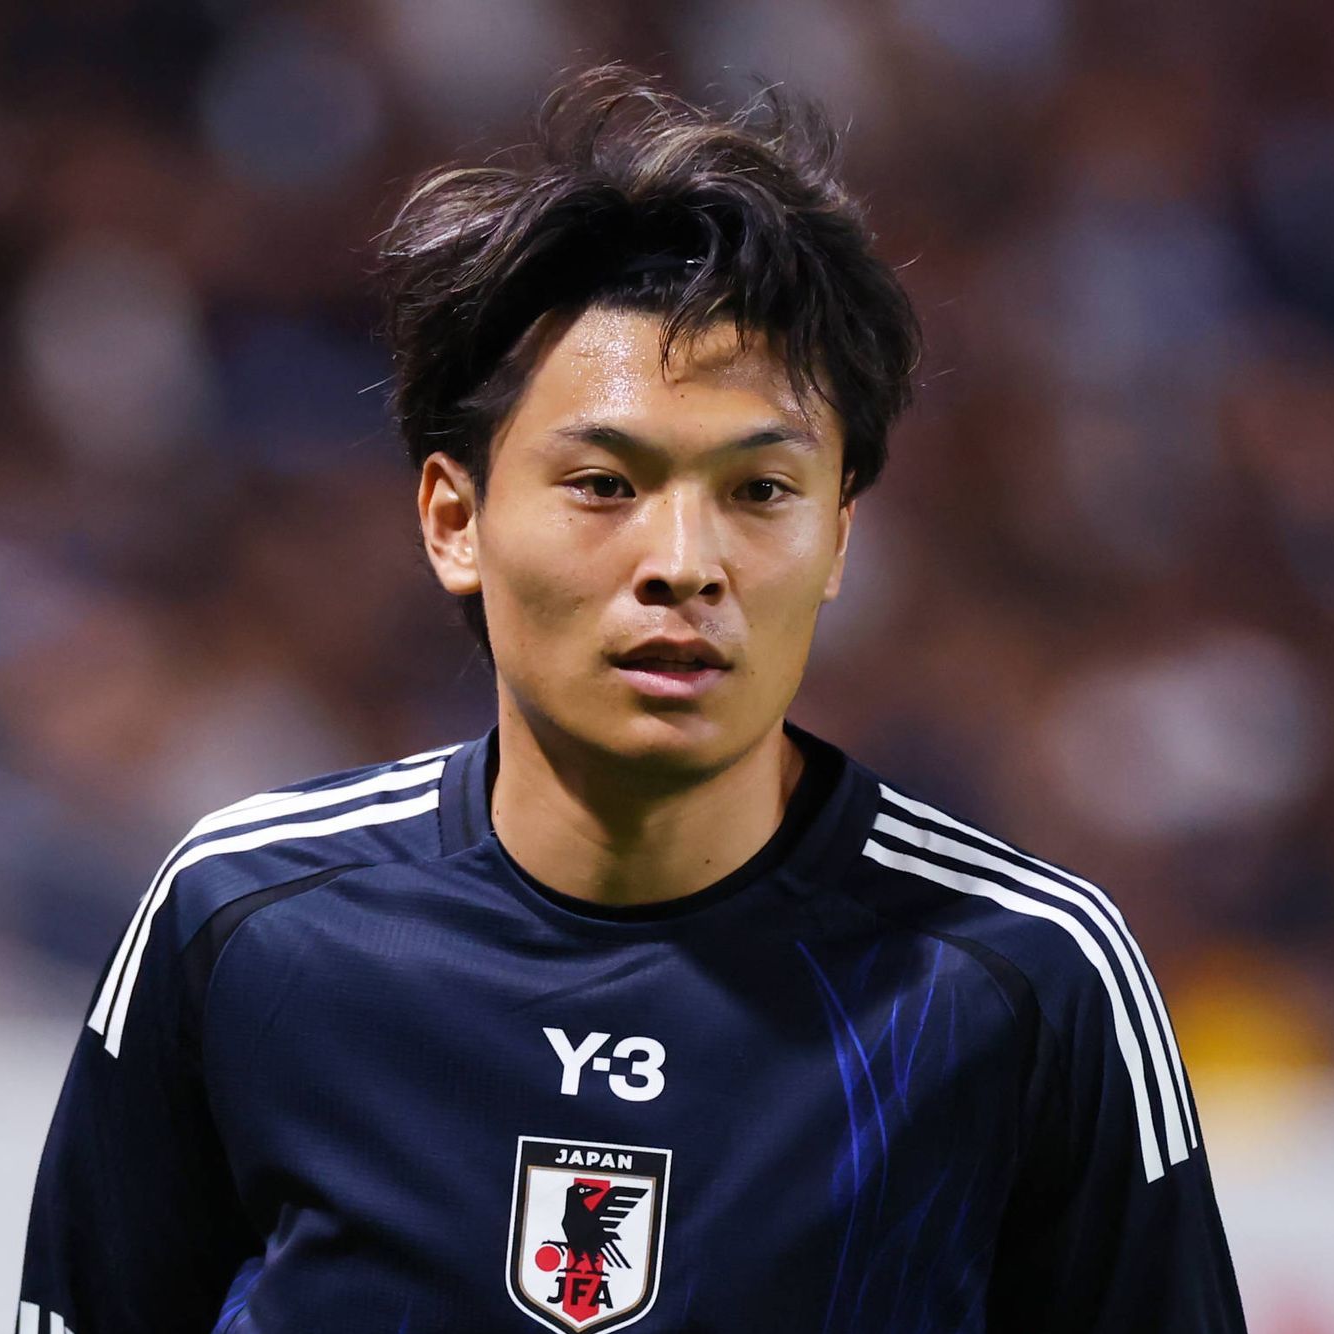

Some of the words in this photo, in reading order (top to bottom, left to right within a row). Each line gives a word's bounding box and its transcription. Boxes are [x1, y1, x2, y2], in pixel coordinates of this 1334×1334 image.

[543, 1027, 666, 1101] Y-3
[555, 1149, 632, 1169] JAPAN
[547, 1276, 613, 1308] JFA
